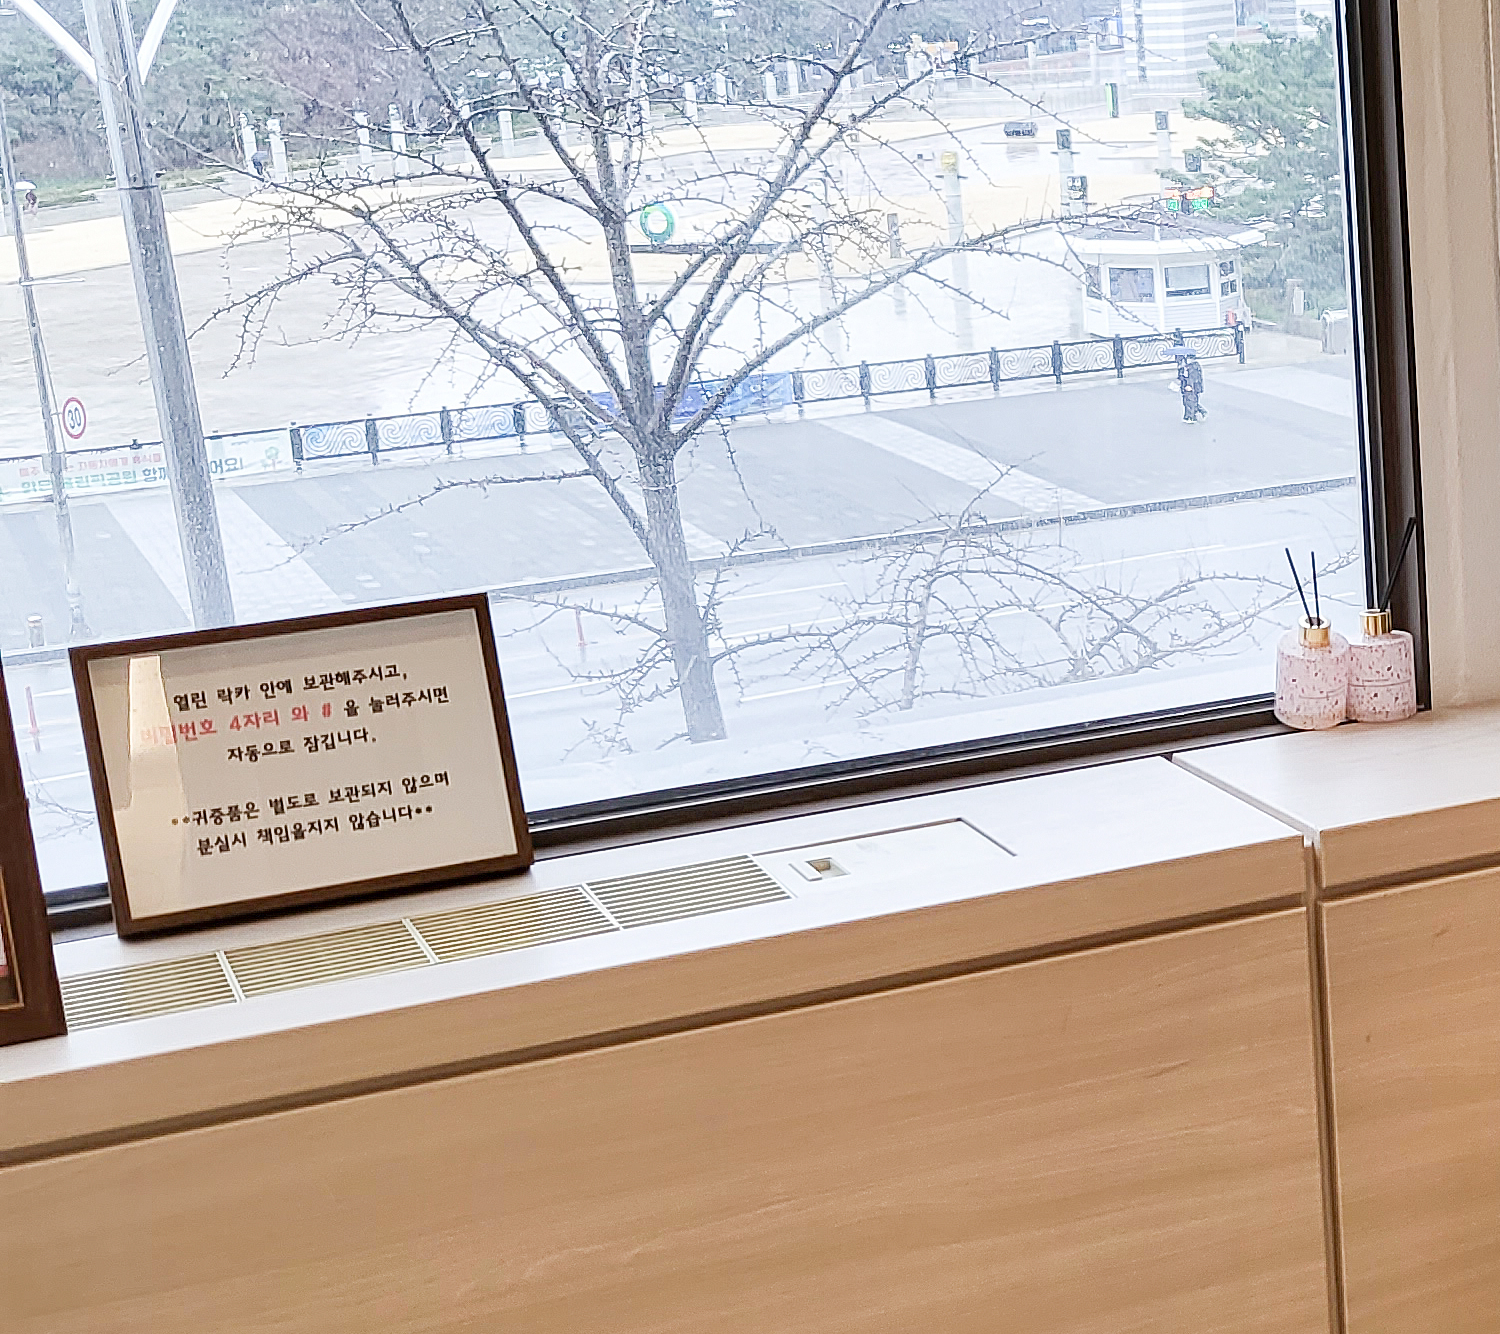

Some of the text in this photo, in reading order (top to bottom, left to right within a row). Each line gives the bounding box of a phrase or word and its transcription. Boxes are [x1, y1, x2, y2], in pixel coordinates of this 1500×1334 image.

[67, 407, 82, 430] 30
[173, 664, 408, 712] 열린 락카 안에 보관해주시고,
[229, 708, 280, 732] 4자리
[291, 704, 309, 722] 와
[344, 698, 360, 718] 을
[368, 685, 450, 714] 눌러주시면
[227, 726, 377, 763] 자동으로 잠깁니다.
[268, 792, 320, 816] 별도로
[328, 780, 393, 804] 보관되지
[401, 770, 450, 795] 않으며
[197, 831, 247, 856] 분실시
